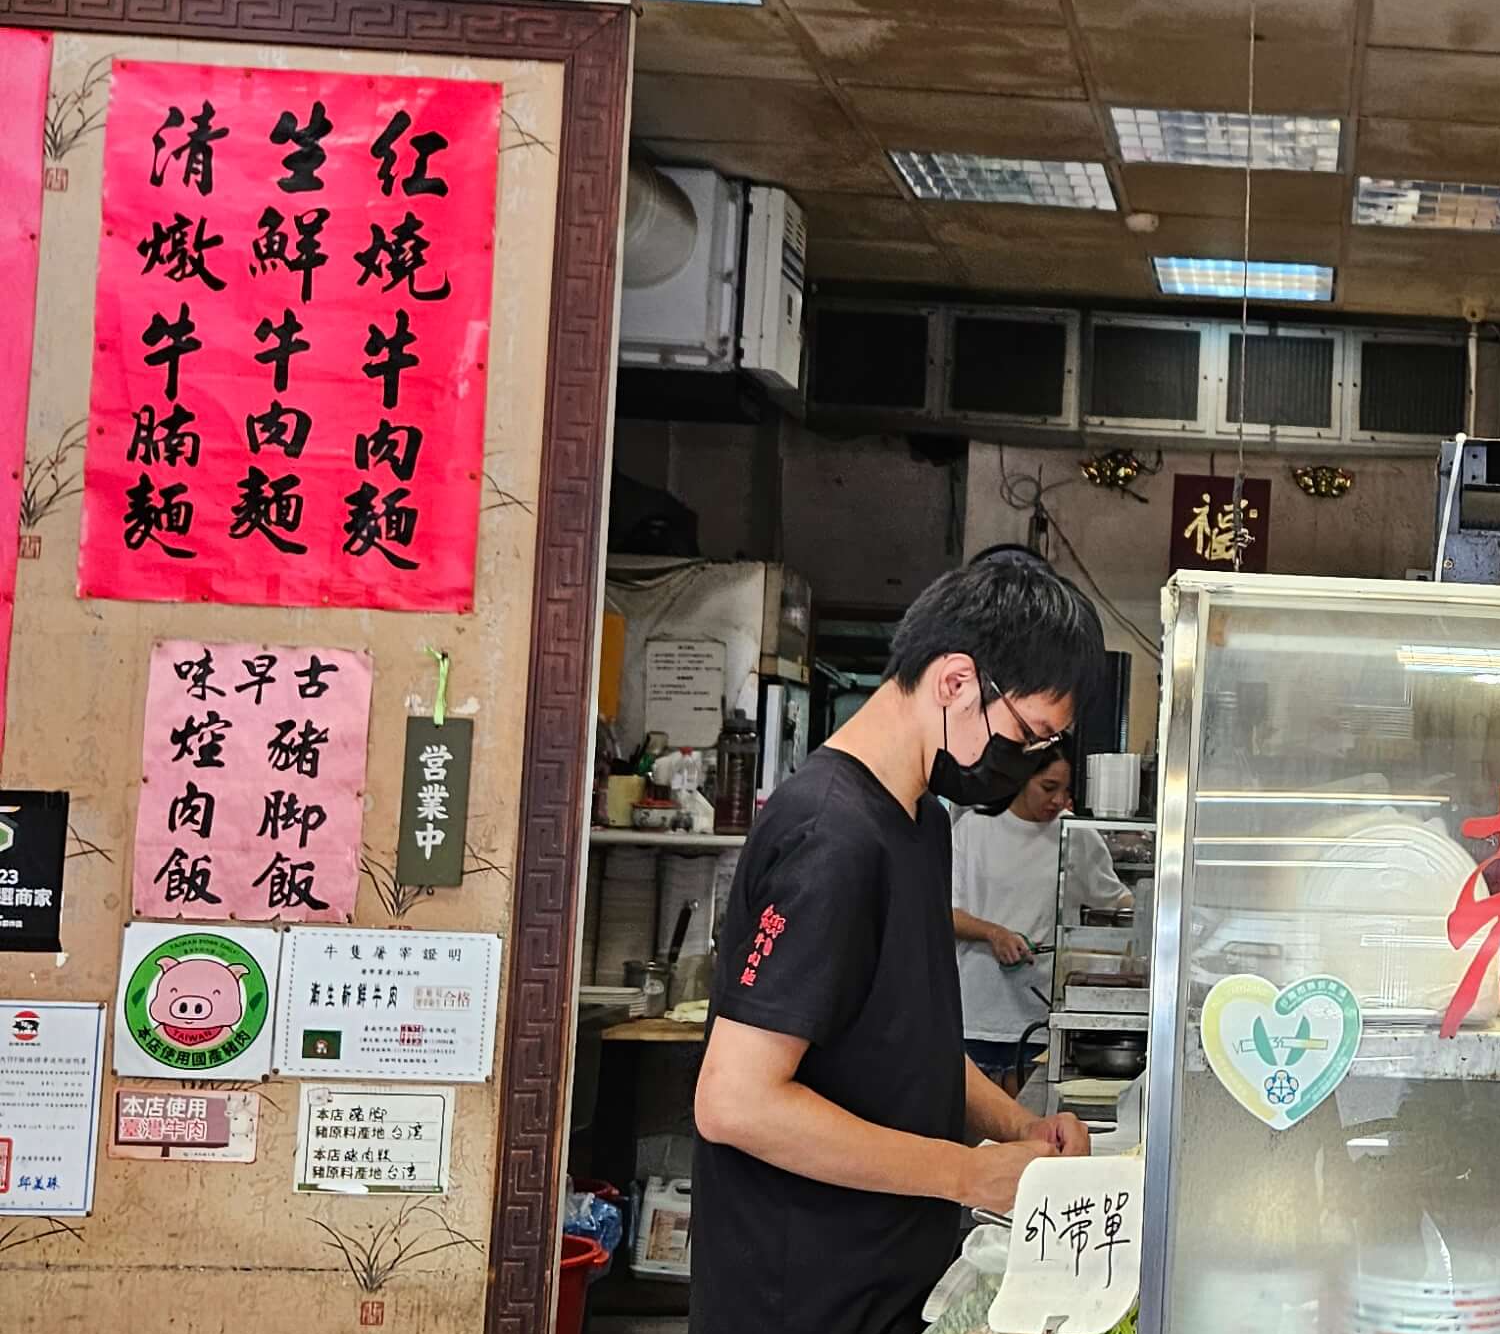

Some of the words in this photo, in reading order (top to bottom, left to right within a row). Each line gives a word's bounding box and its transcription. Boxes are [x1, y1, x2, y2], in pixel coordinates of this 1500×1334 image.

[123, 99, 231, 560] 清燉牛腩麵
[228, 101, 335, 556] 生鮮牛肉麵
[342, 110, 453, 571] 紅燒牛肉麵
[173, 648, 339, 705] 古早味
[174, 1030, 212, 1041] TAIWAN
[122, 1095, 208, 1118] 本店使用
[316, 1107, 345, 1121] 本店
[313, 1148, 341, 1162] 本店
[1025, 1192, 1131, 1289] 外帶單
